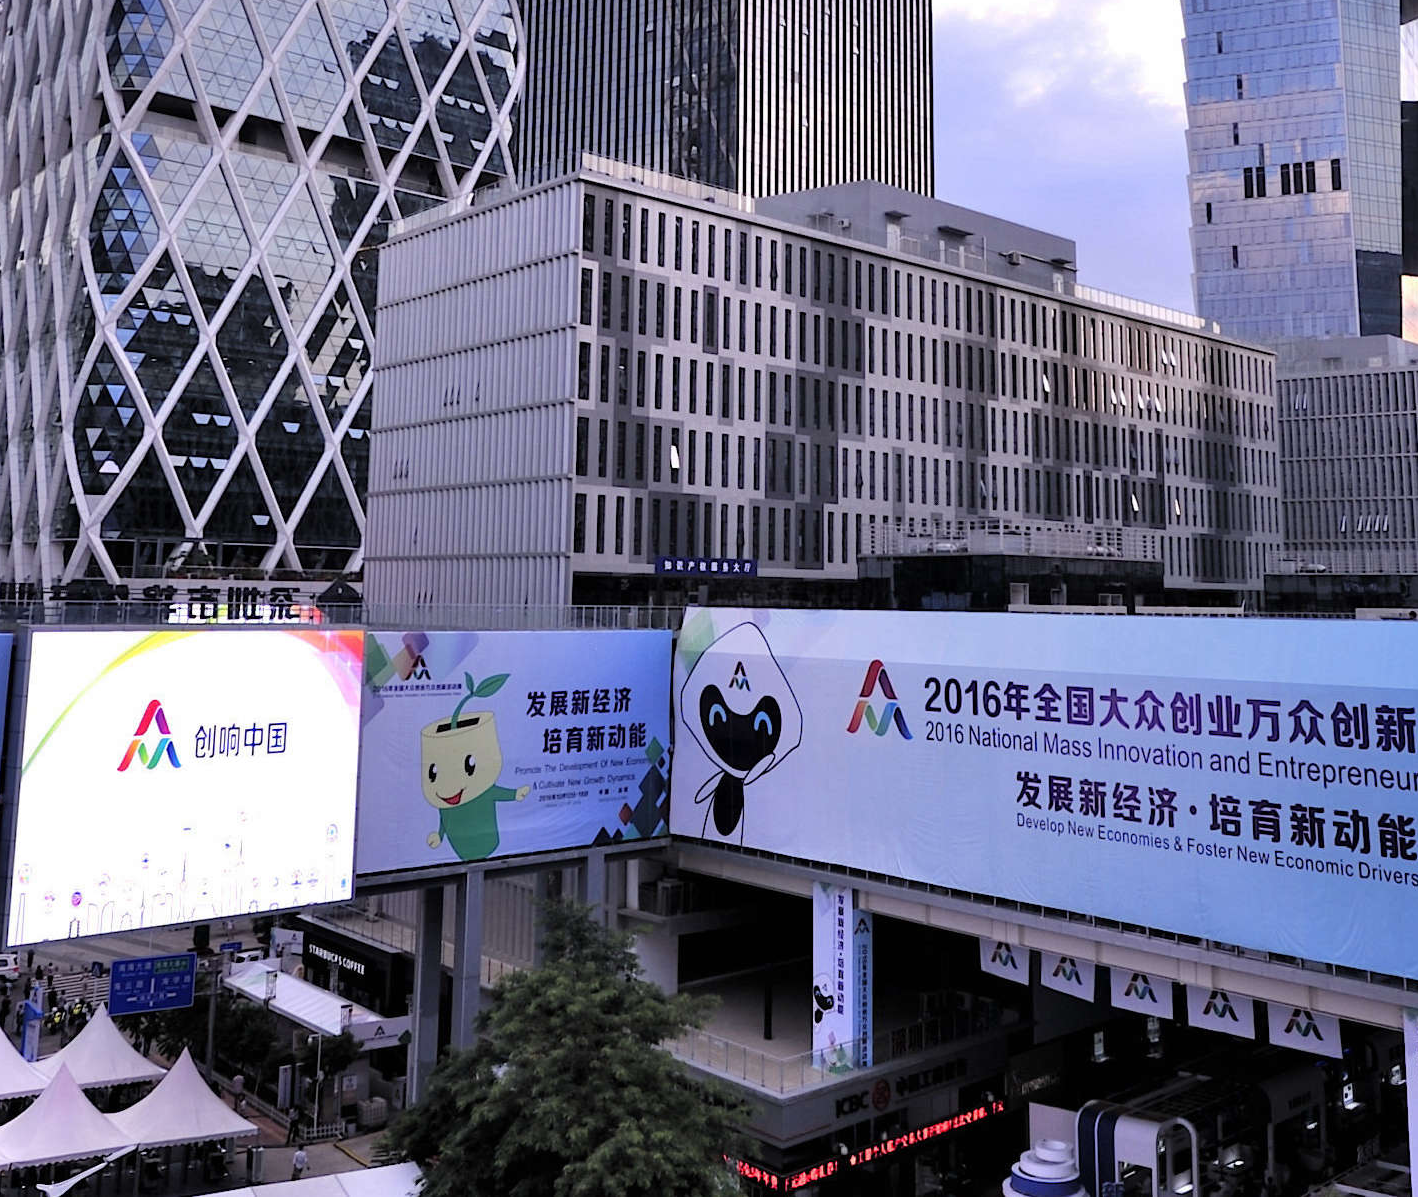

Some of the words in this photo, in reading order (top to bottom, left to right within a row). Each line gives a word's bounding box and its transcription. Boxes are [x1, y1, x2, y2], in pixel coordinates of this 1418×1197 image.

[526, 687, 632, 718] 发展新经济
[195, 722, 288, 758] 创响中国
[543, 722, 647, 754] 培育新动能
[925, 720, 964, 744] 2016
[969, 725, 1038, 753] National
[1043, 733, 1092, 758] Mass
[1098, 742, 1203, 770] Innovation
[1209, 751, 1250, 774] and
[1016, 812, 1065, 836] Develop
[1067, 821, 1094, 838] New
[1098, 825, 1170, 851] Economies
[1173, 836, 1183, 852] &
[1187, 838, 1233, 860] Foster
[1237, 845, 1270, 866] New
[1275, 850, 1354, 877] Economic
[309, 944, 342, 966] STARBUCKS
[343, 957, 365, 976] COFFEE
